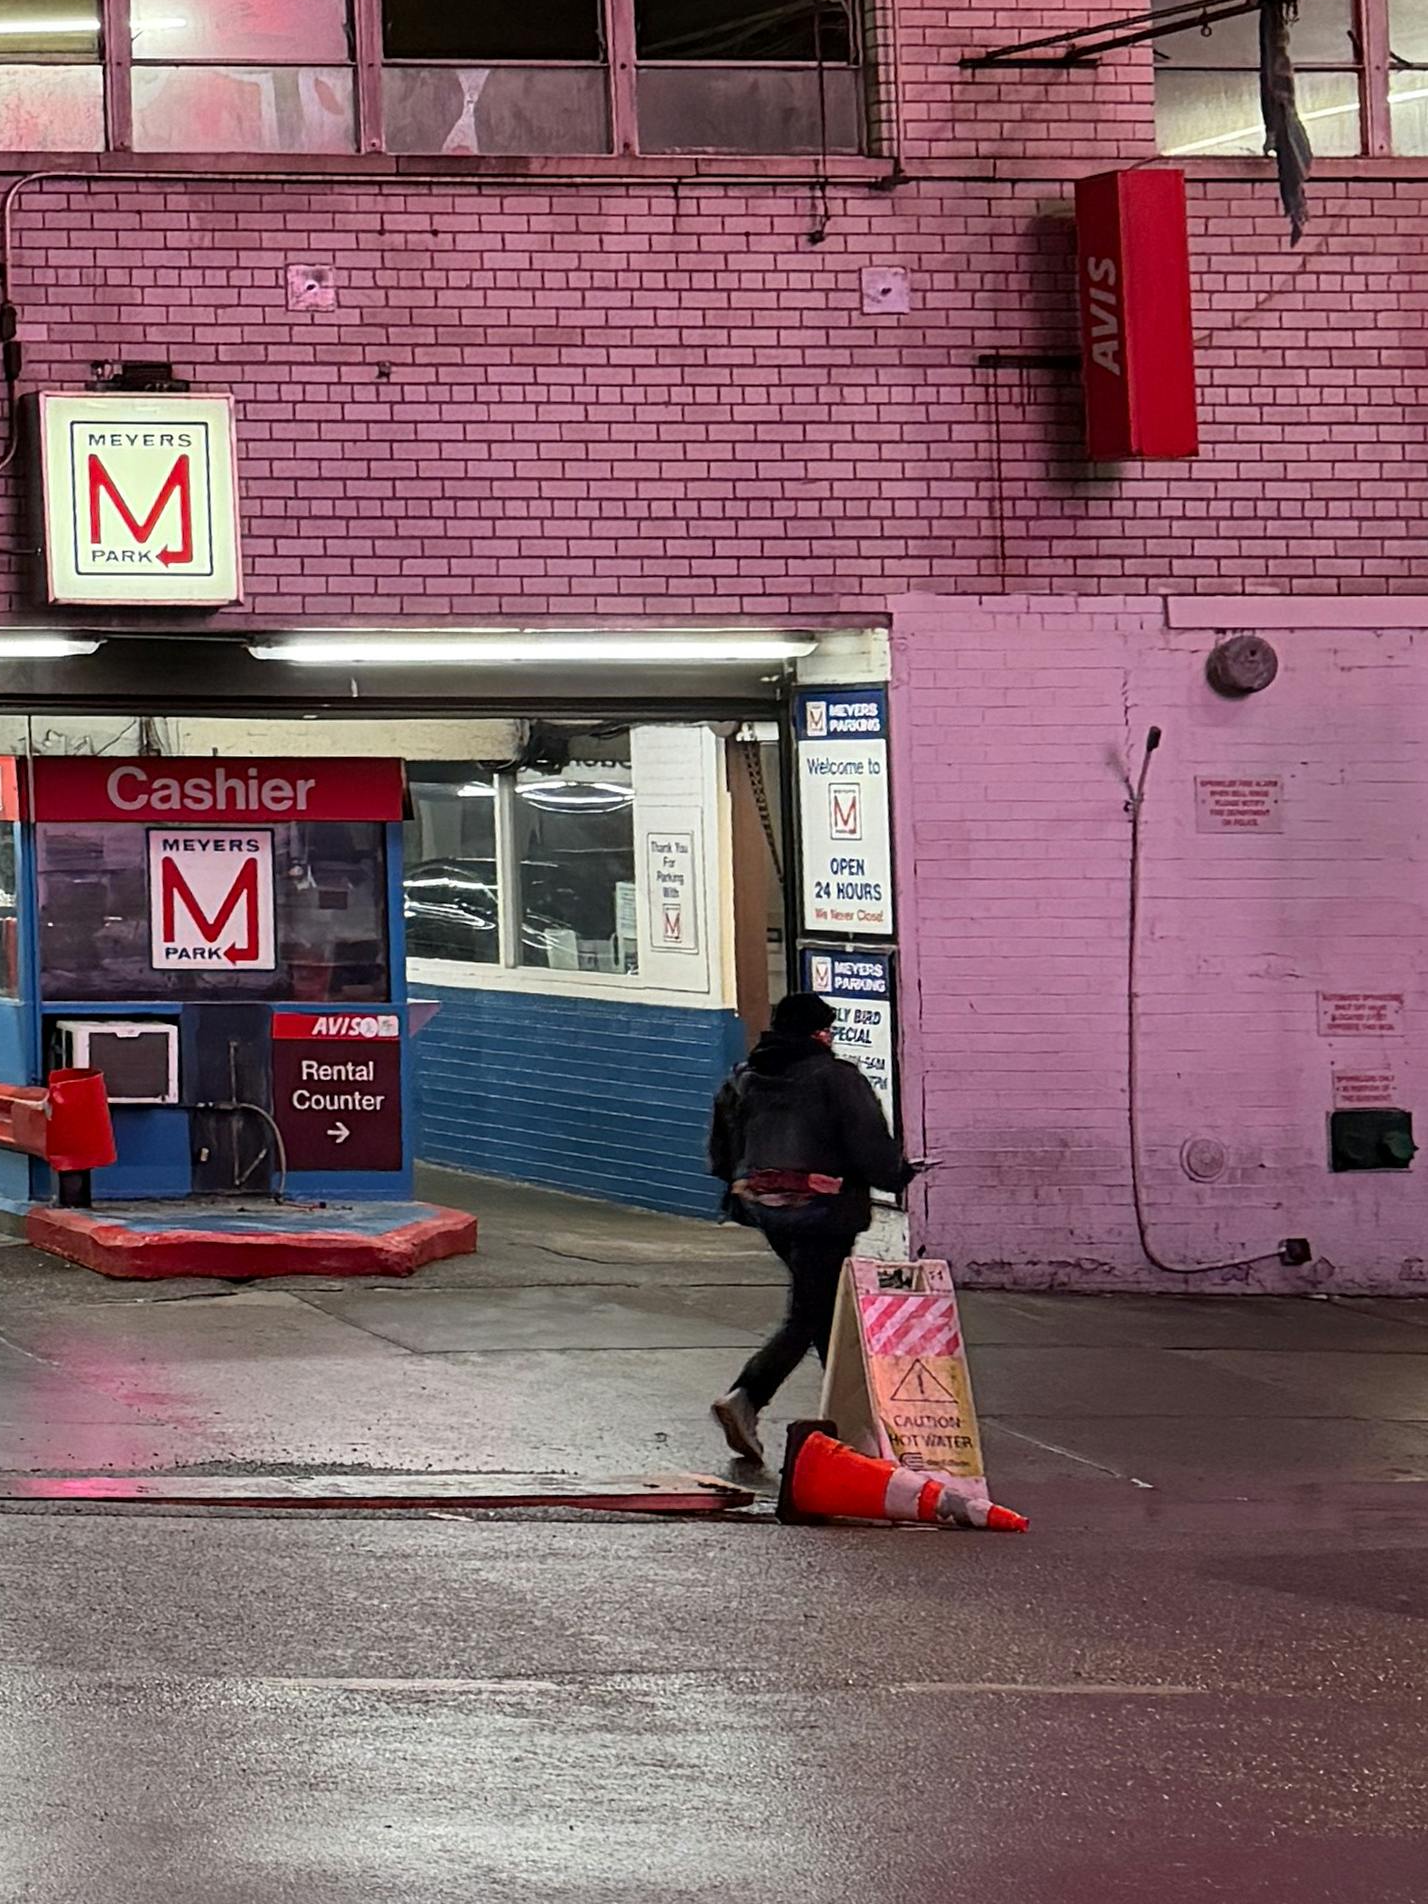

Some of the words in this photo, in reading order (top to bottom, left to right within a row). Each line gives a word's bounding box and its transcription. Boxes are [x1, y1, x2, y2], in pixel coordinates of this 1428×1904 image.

[1087, 256, 1121, 377] AVIS
[88, 433, 192, 447] MEYERS
[92, 549, 152, 563] PARK
[829, 703, 878, 717] MEYERS
[807, 757, 864, 776] Welcome
[868, 758, 881, 775] to
[106, 765, 317, 813] Cashier
[161, 838, 261, 854] MEYERS
[830, 857, 865, 876] OPEN
[815, 881, 832, 899] 24
[837, 882, 882, 900] HOURS
[164, 947, 222, 961] PARK
[834, 960, 884, 977] MEYERS
[834, 979, 886, 993] PARKING
[853, 1008, 881, 1025] BIRD
[311, 1016, 362, 1036] AVIS
[832, 1026, 872, 1043] PECIAL
[301, 1059, 374, 1081] Rental
[292, 1089, 385, 1110] Counter
[893, 1414, 961, 1428] CAUTION
[889, 1434, 920, 1447] HOT
[921, 1435, 973, 1449] WATER
